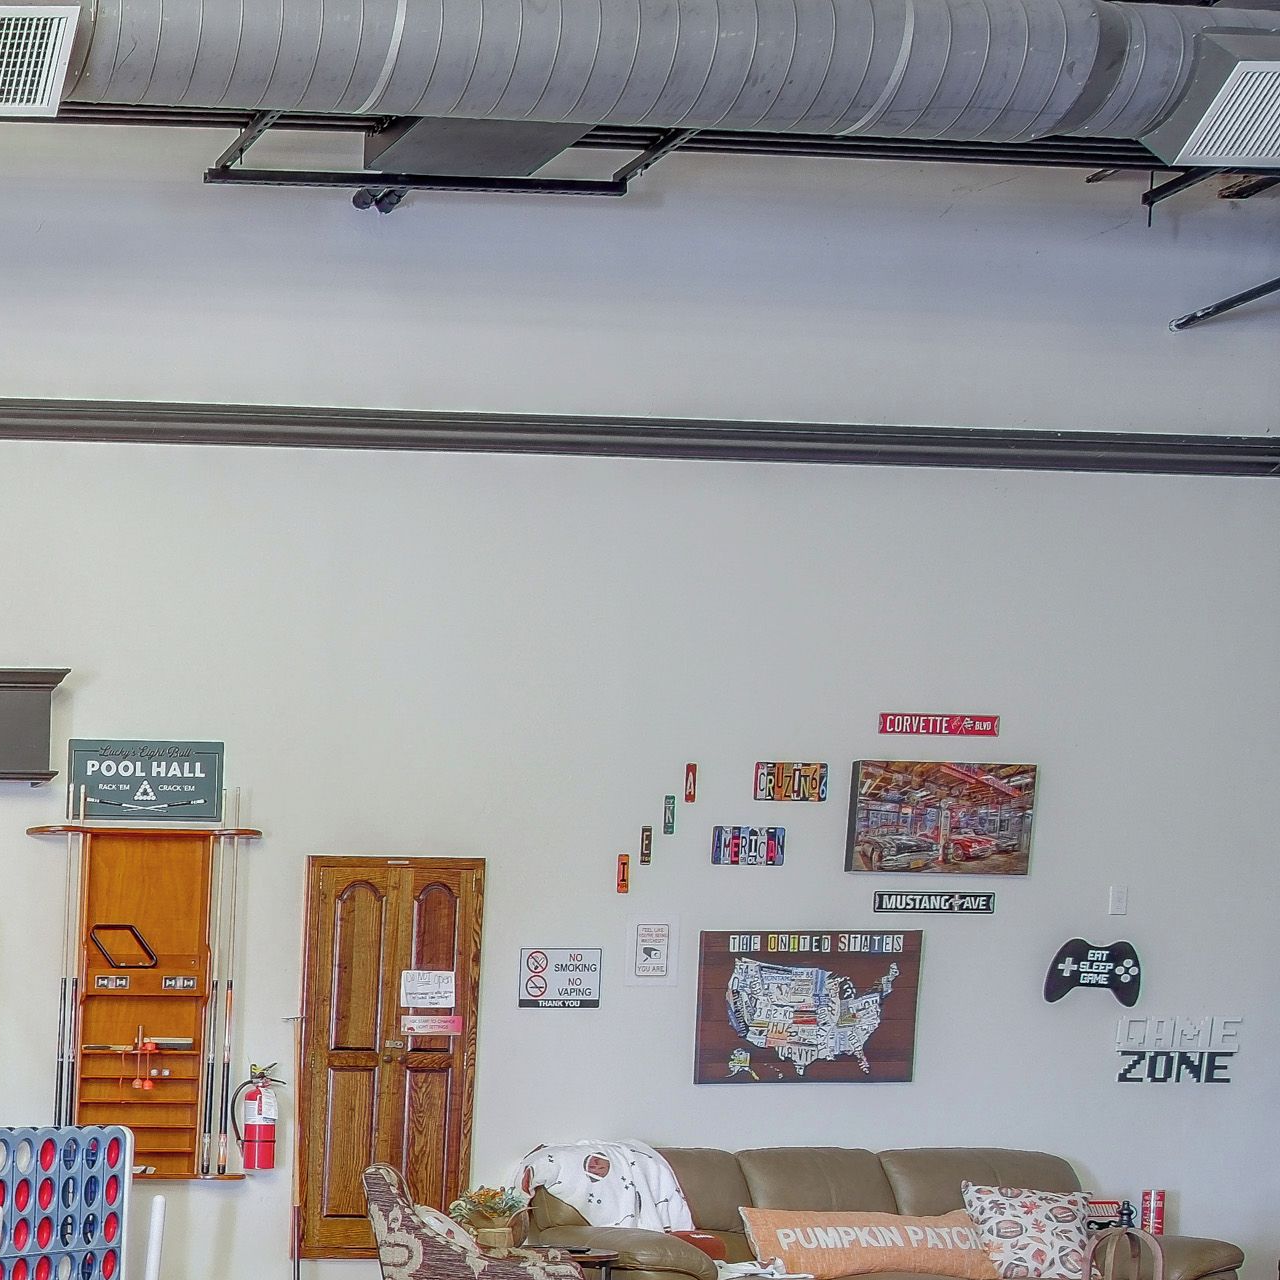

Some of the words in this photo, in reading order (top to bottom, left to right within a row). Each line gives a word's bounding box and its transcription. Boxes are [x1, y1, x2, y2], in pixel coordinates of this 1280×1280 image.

[886, 716, 950, 734] CORVETTE
[974, 721, 992, 731] BLVD
[98, 745, 137, 760] Lucky's
[139, 745, 165, 761] Eight
[167, 746, 193, 758] Ball
[86, 760, 146, 777] POOL
[151, 761, 206, 778] HALL
[98, 783, 117, 791] RACK
[158, 784, 182, 792] CRACK
[881, 894, 950, 910] MUSTANG
[962, 896, 987, 910] AVE
[730, 935, 760, 952] THE
[768, 935, 831, 952] UNITED
[838, 934, 903, 952] STATES
[568, 953, 583, 962] NO
[1087, 950, 1110, 961] EAT
[554, 963, 597, 972] SMOKING
[1079, 962, 1113, 972] SLEEP
[568, 977, 582, 986] NO
[1079, 974, 1110, 985] GAME
[557, 987, 592, 996] VAPING
[1116, 1016, 1243, 1051] GAME
[1117, 1052, 1234, 1083] ZONE
[776, 1225, 904, 1251] PUMPKIN
[903, 1224, 985, 1251] PATCH
